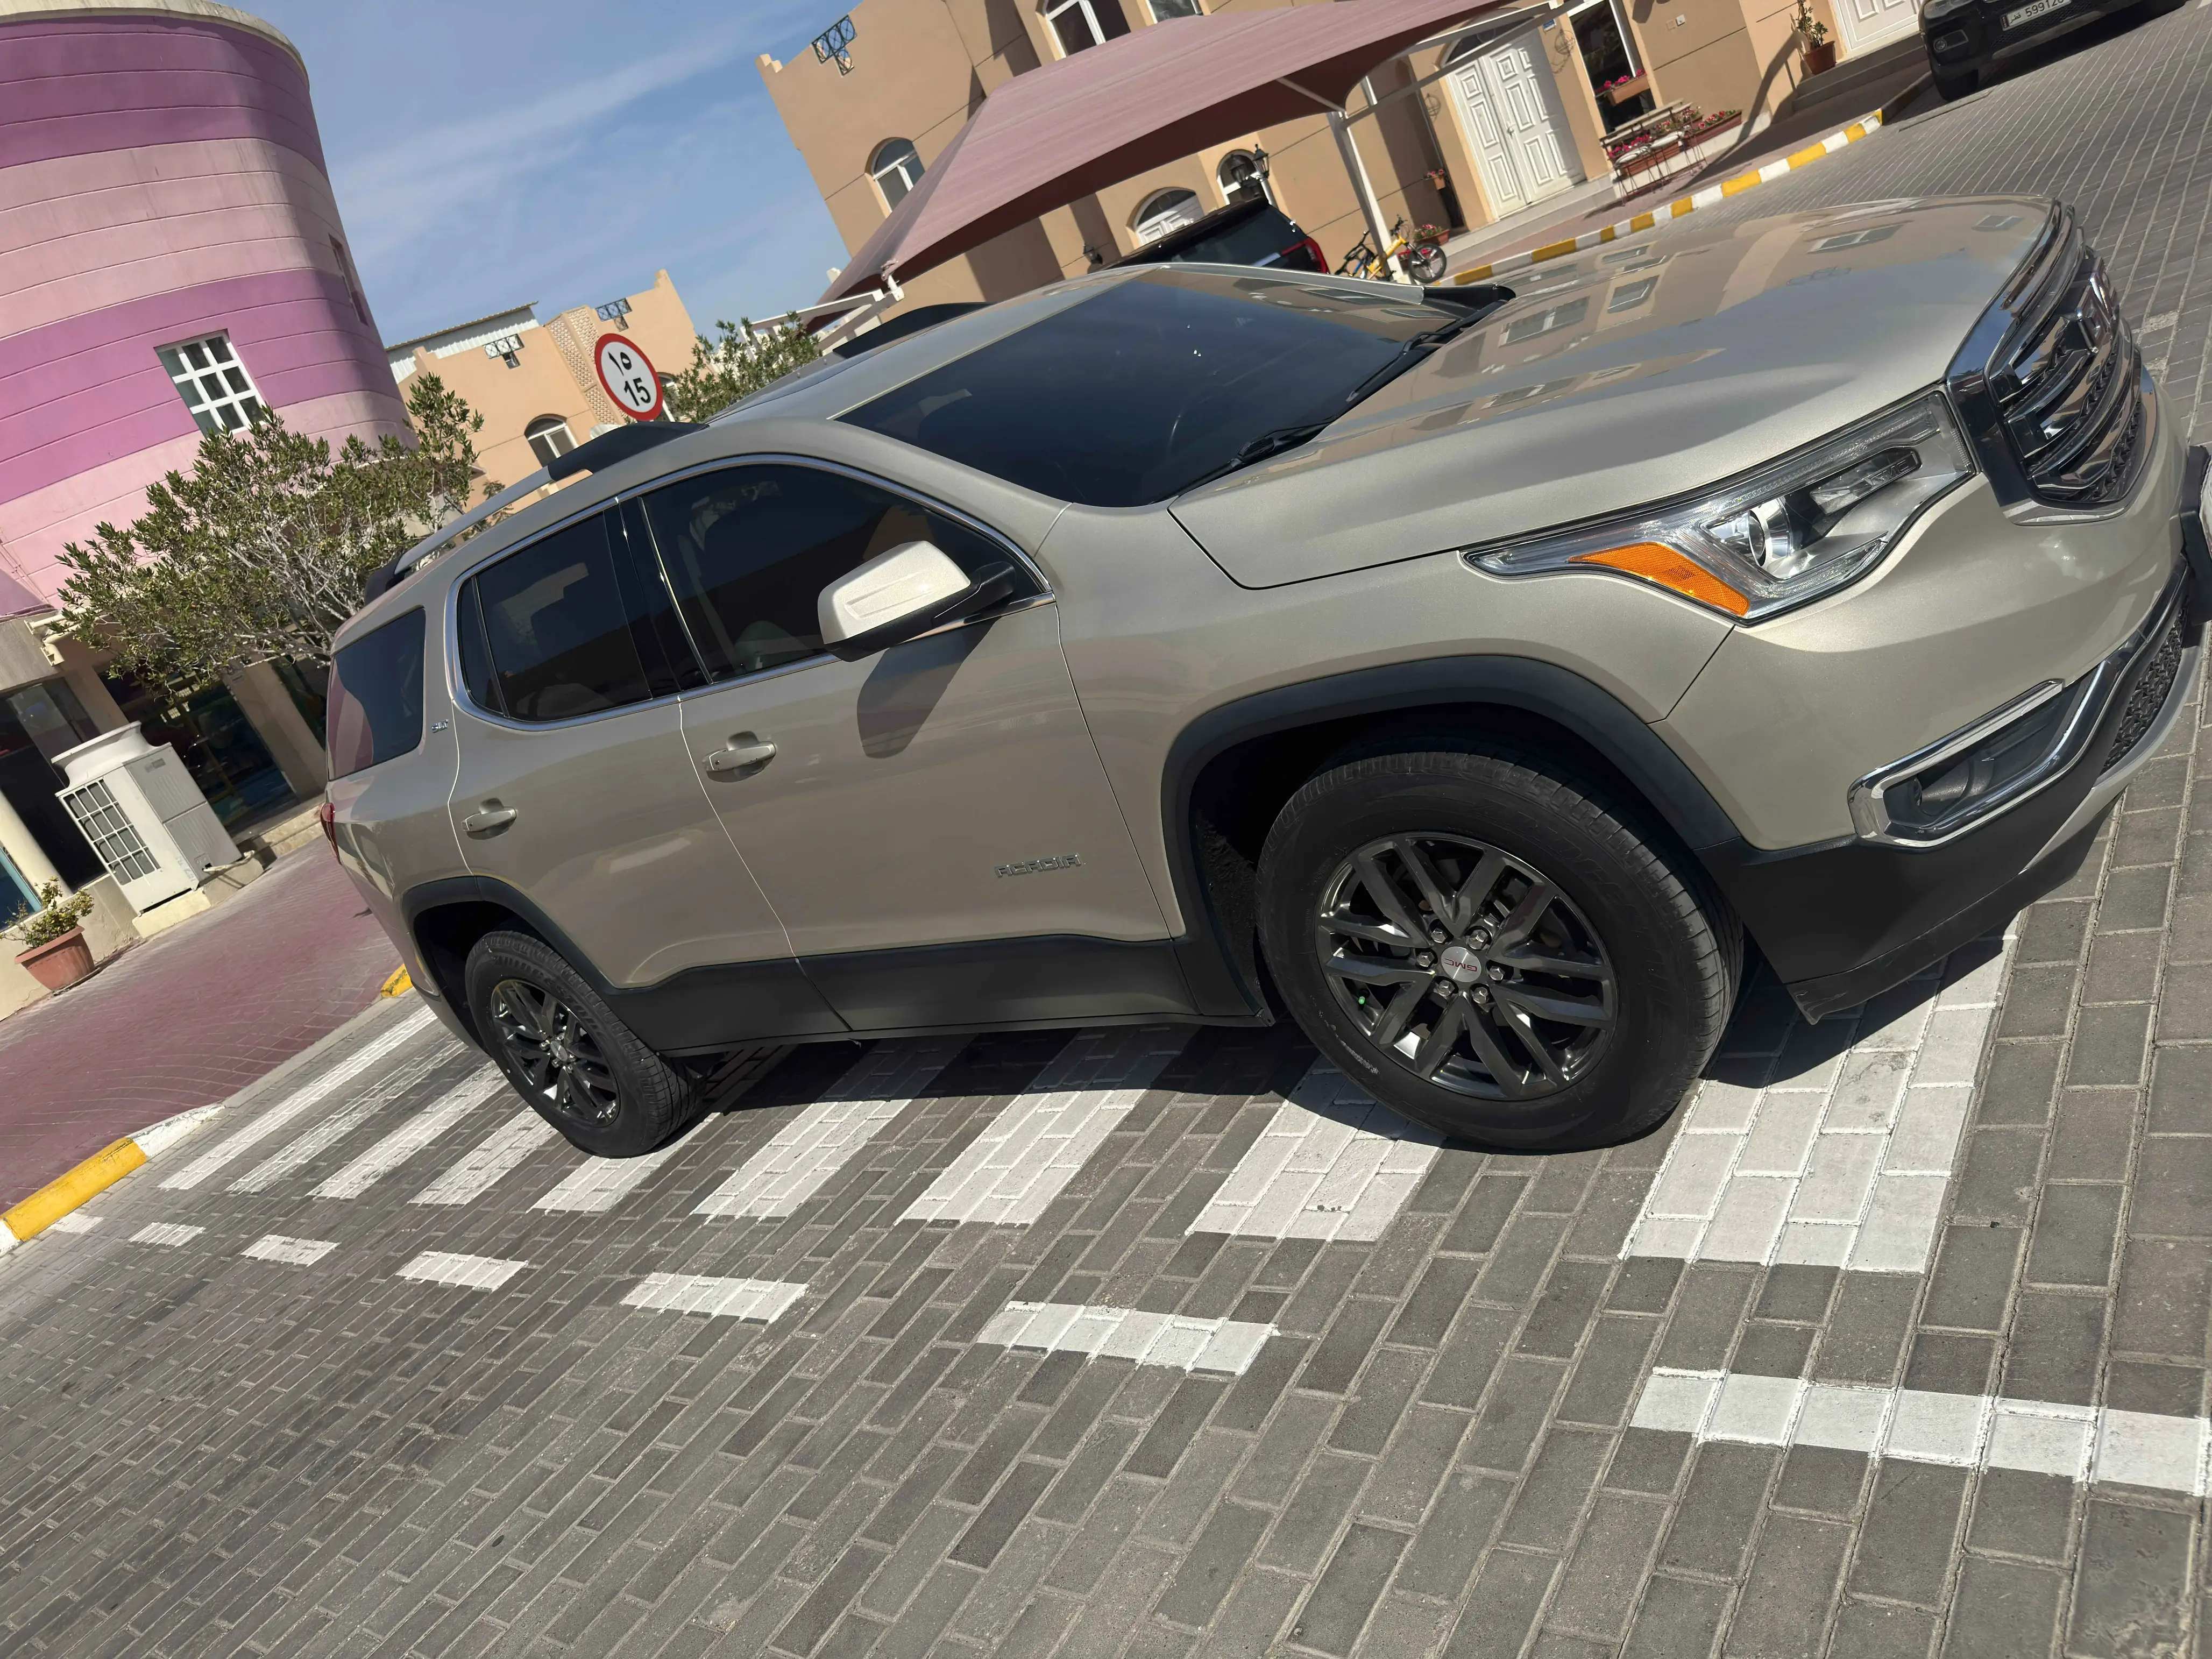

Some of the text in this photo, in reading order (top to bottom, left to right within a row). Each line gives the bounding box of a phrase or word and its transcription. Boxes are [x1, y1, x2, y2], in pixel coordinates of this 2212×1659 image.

[2010, 12, 2022, 24] قطر
[608, 351, 632, 376] ١٥
[624, 377, 651, 406] 15
[995, 853, 1082, 878] ACADIA
[1443, 958, 1477, 972] GMC
